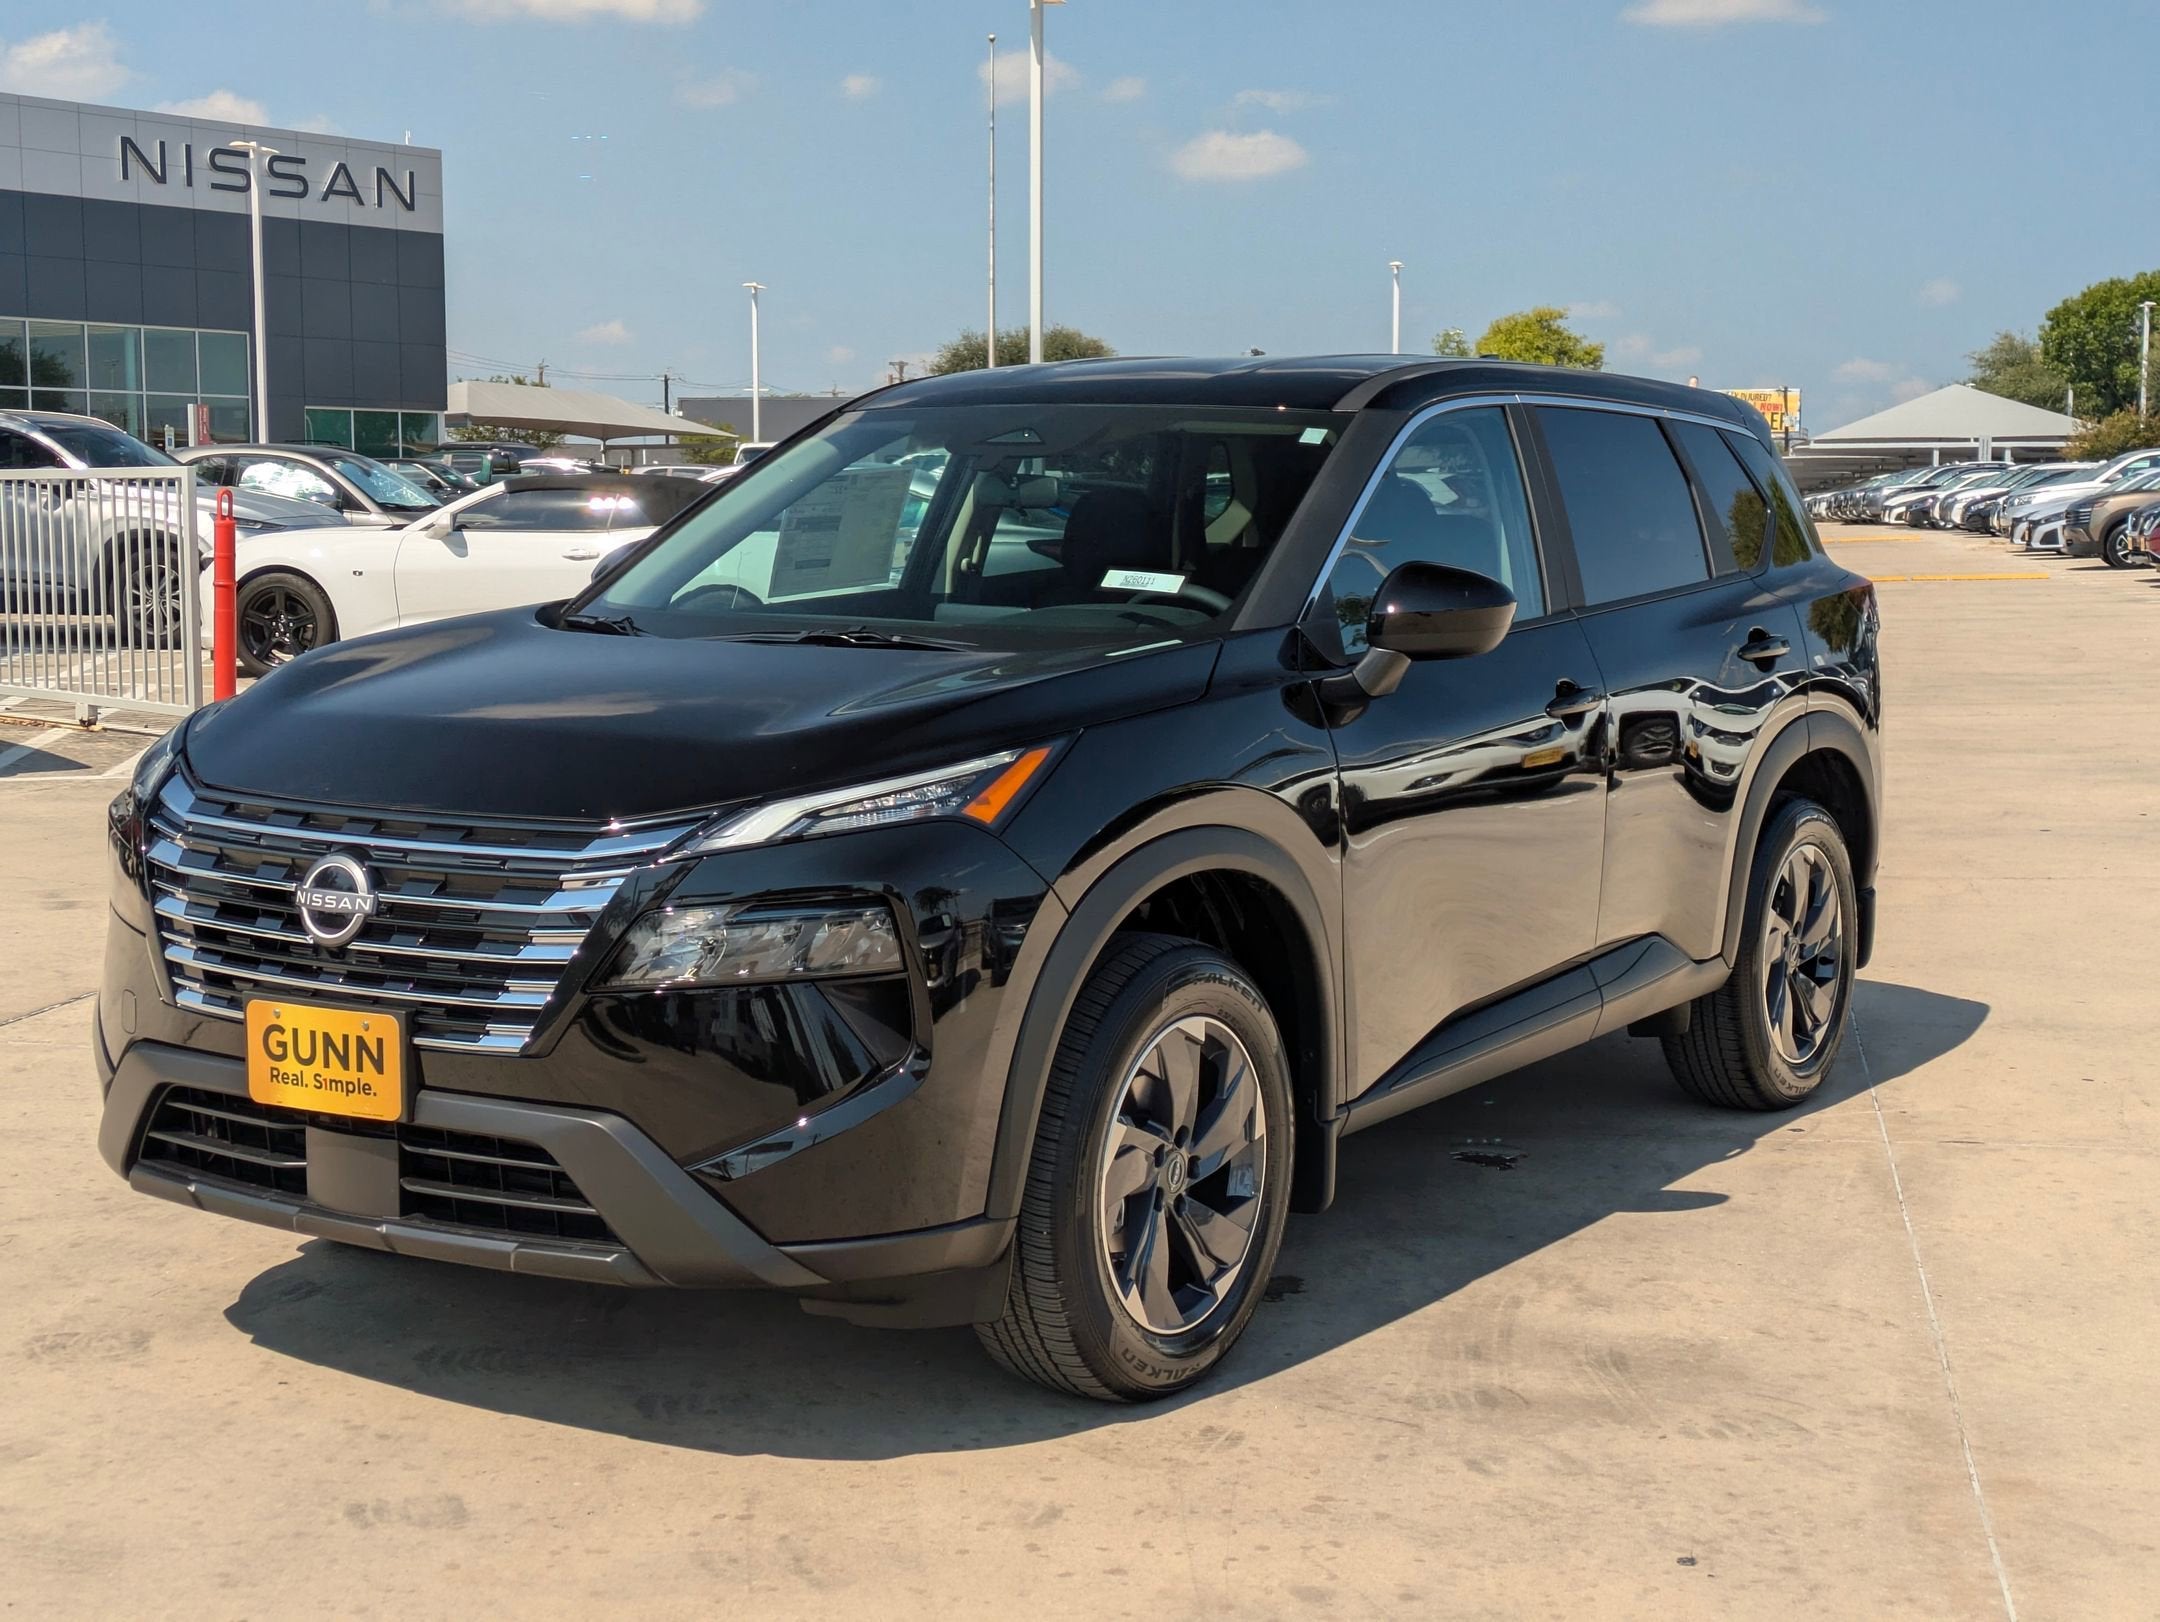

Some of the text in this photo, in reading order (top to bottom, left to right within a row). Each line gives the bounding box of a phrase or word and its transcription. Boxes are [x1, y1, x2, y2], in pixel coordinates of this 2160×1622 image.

[119, 135, 415, 212] NISSAN
[296, 890, 370, 911] NISSAN
[262, 1023, 384, 1075] GUNN
[270, 1066, 309, 1089] Real.
